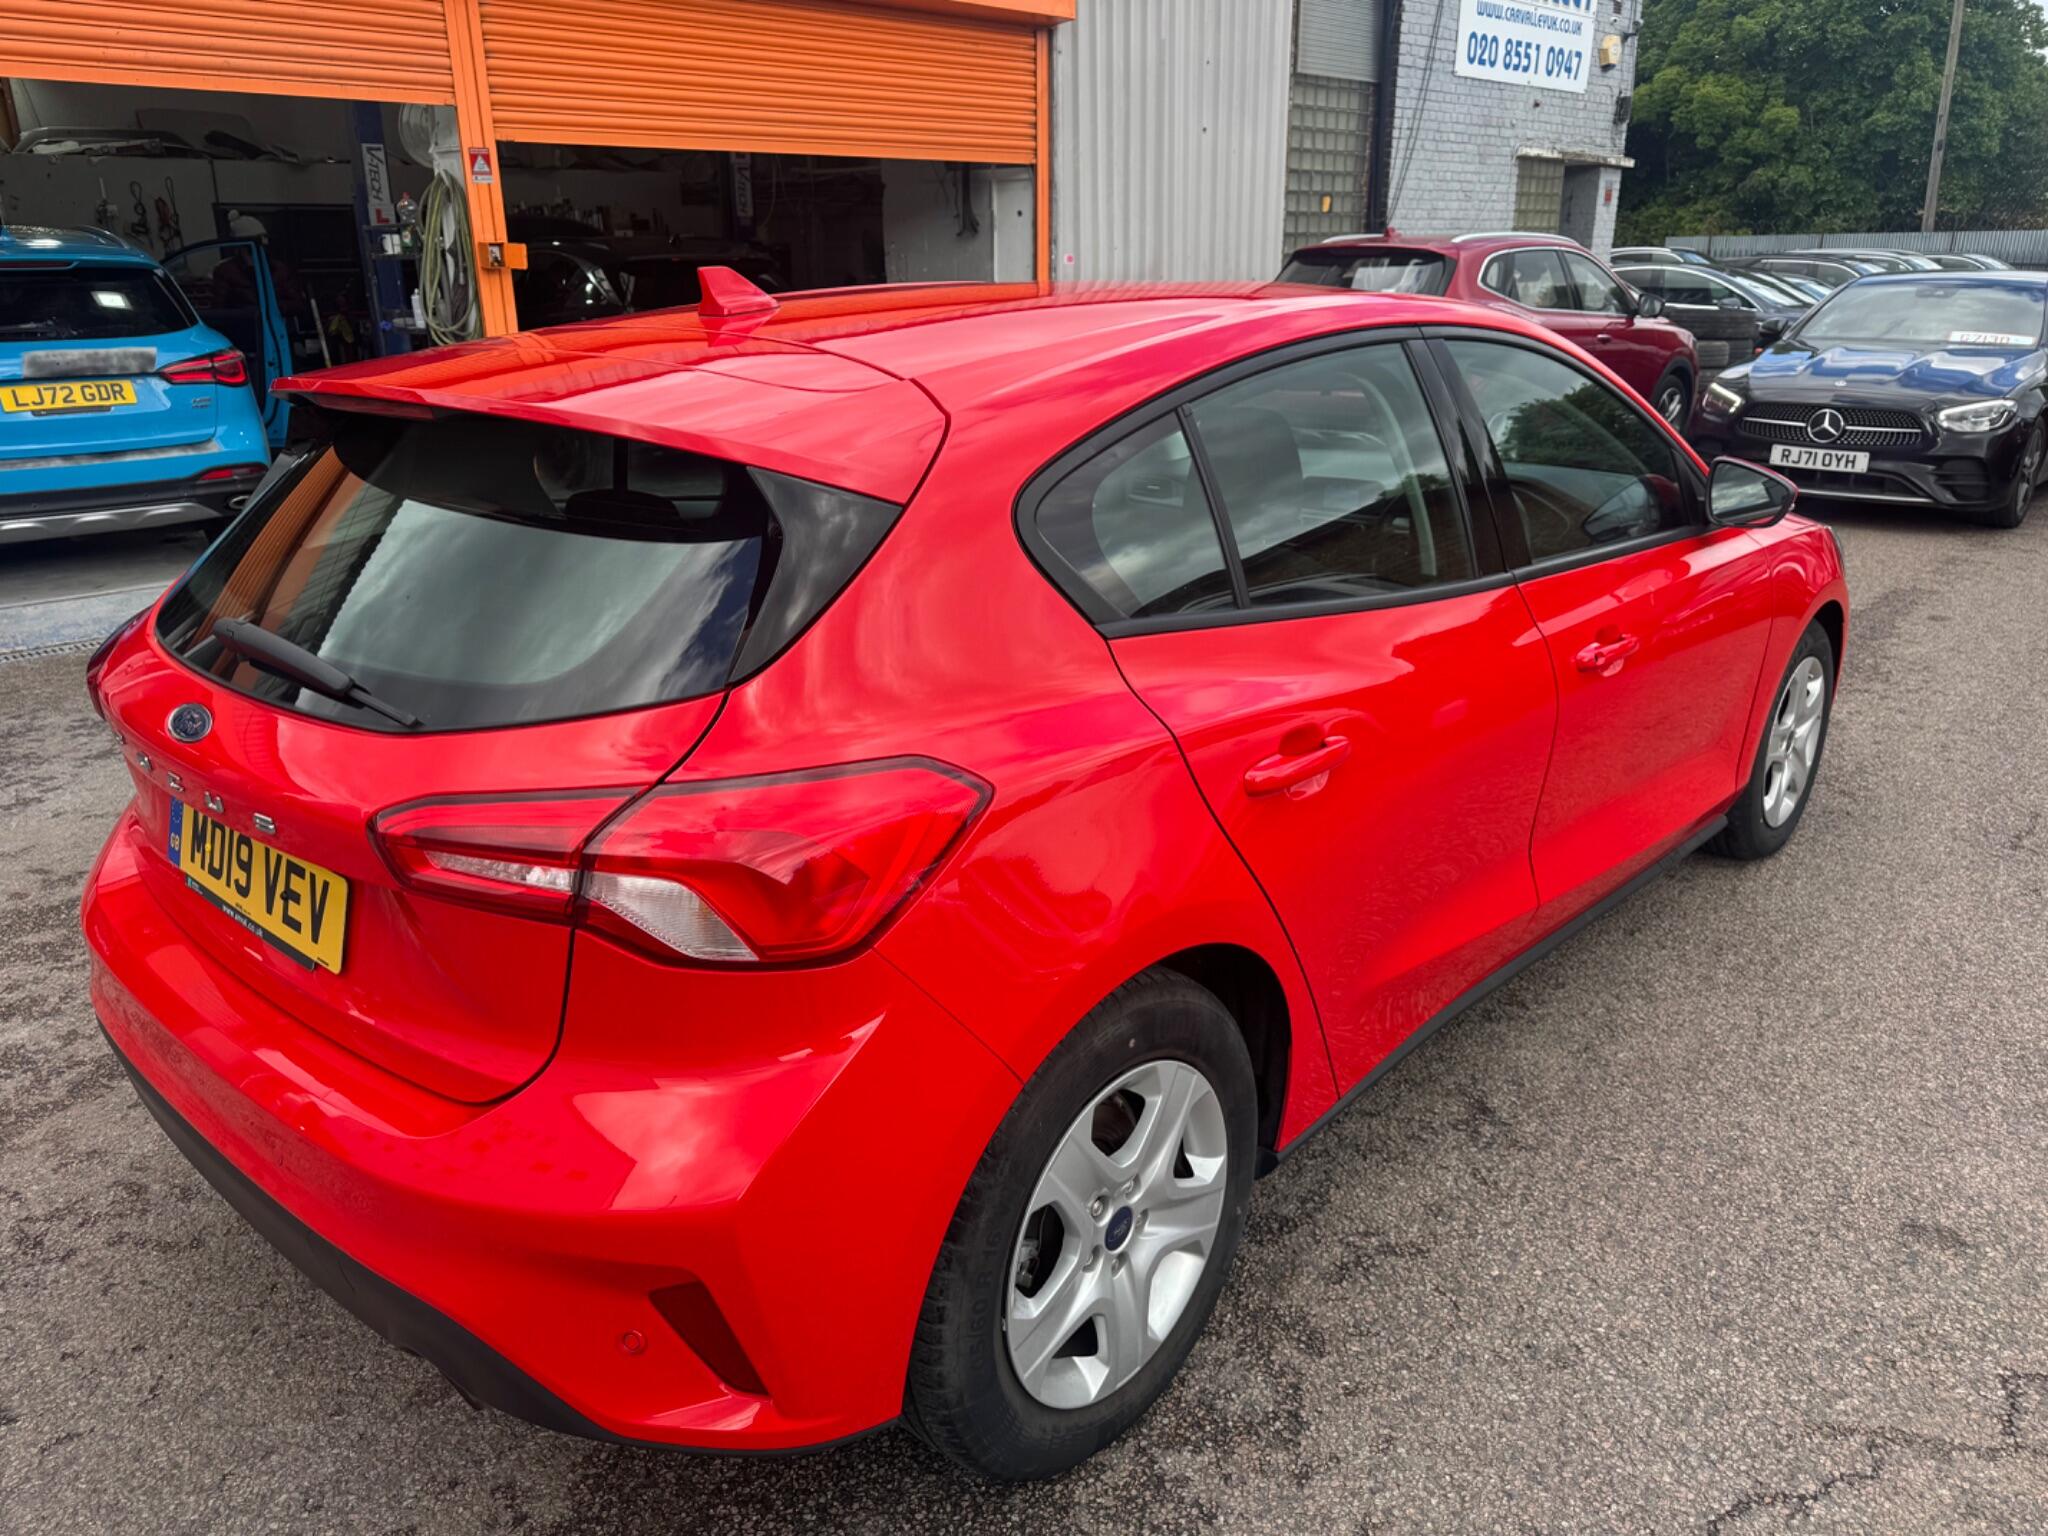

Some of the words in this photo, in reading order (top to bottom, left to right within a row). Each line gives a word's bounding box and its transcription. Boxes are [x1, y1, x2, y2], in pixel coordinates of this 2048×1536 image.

[1467, 31, 1499, 68] 020
[1503, 38, 1541, 74] 8551
[1545, 46, 1583, 80] 0947
[366, 146, 384, 202] V-TECH
[11, 386, 76, 408] LJ72
[80, 383, 126, 402] GDR
[1780, 448, 1818, 467] RJ71
[1821, 452, 1857, 470] OYH
[190, 809, 253, 899] MD19
[264, 846, 330, 945] VEV
